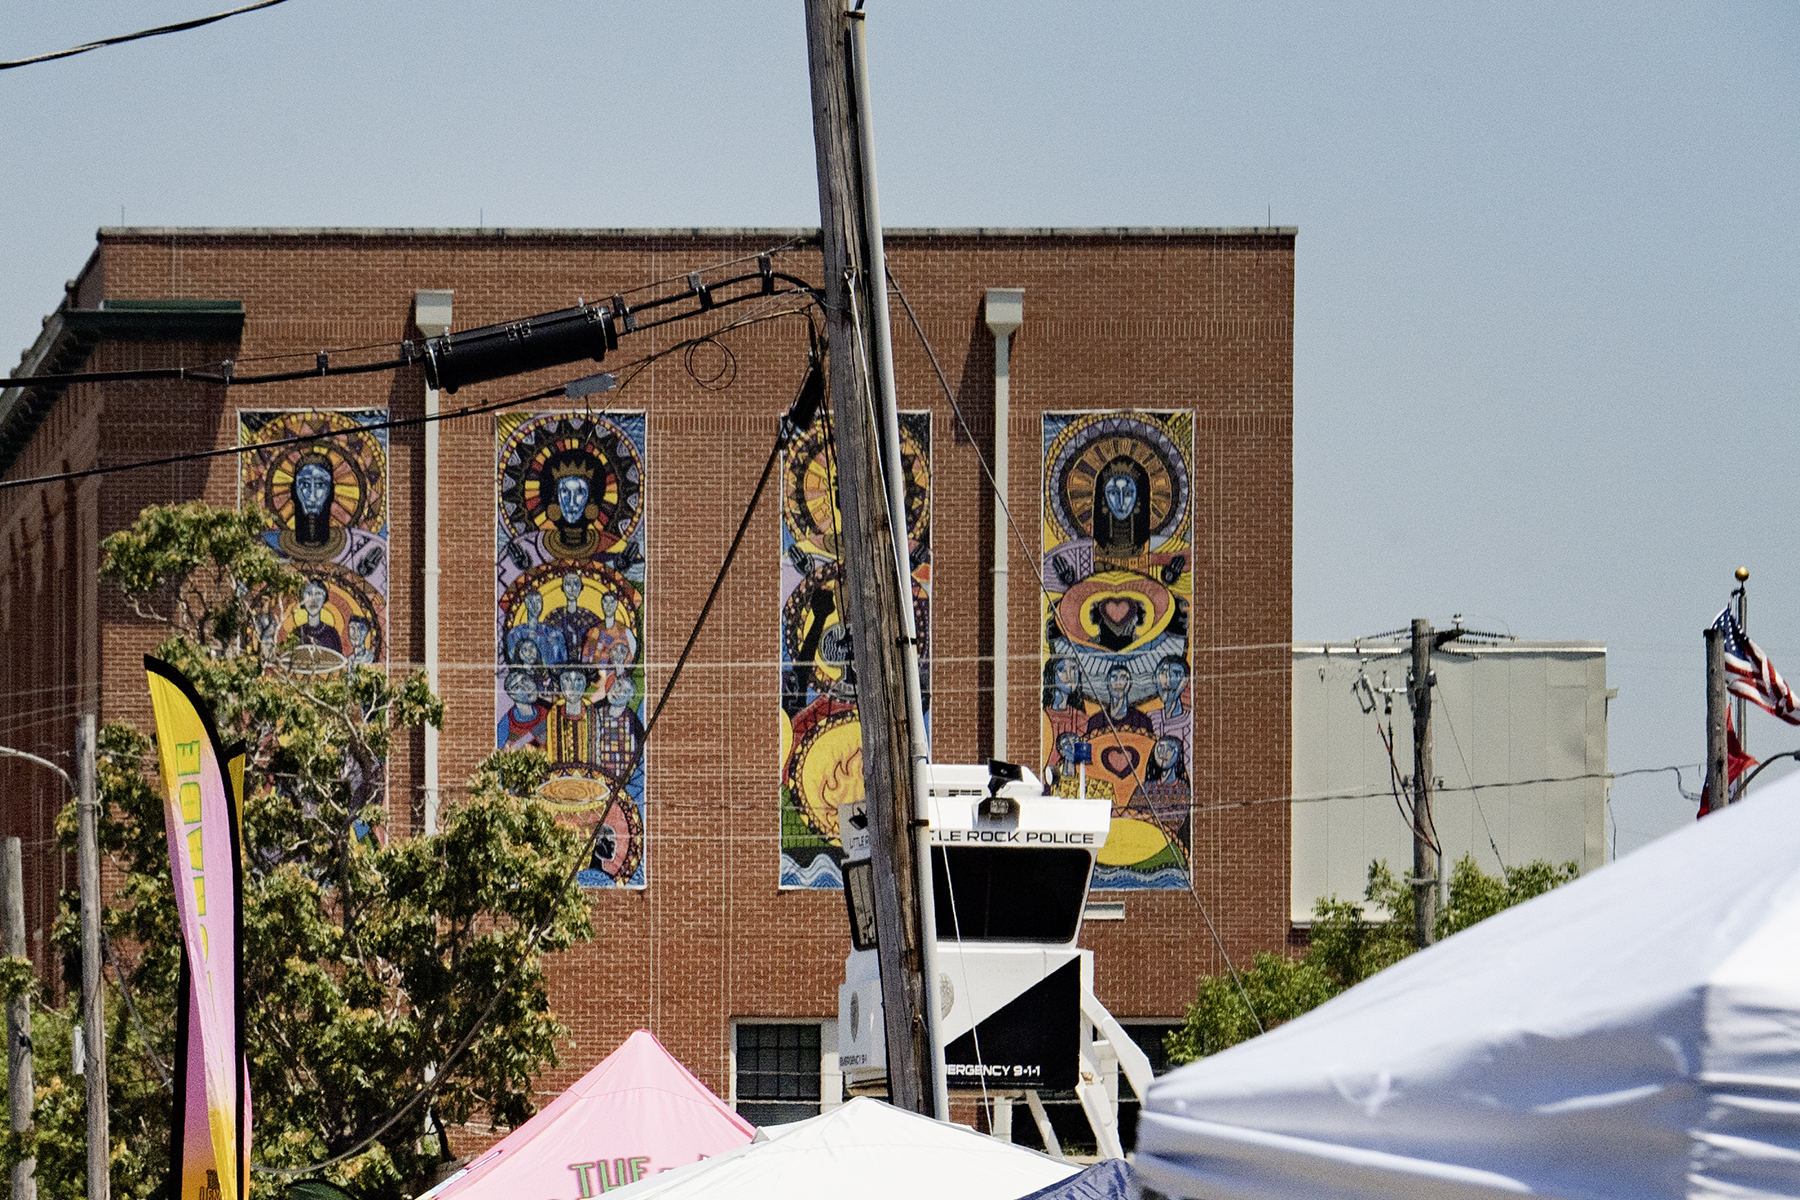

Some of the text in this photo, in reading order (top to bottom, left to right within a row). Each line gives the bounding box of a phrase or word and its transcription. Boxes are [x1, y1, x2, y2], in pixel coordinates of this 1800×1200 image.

[967, 831, 1019, 843] ROCK
[1026, 831, 1095, 844] POLICE
[946, 1064, 1011, 1077] ERGENCY
